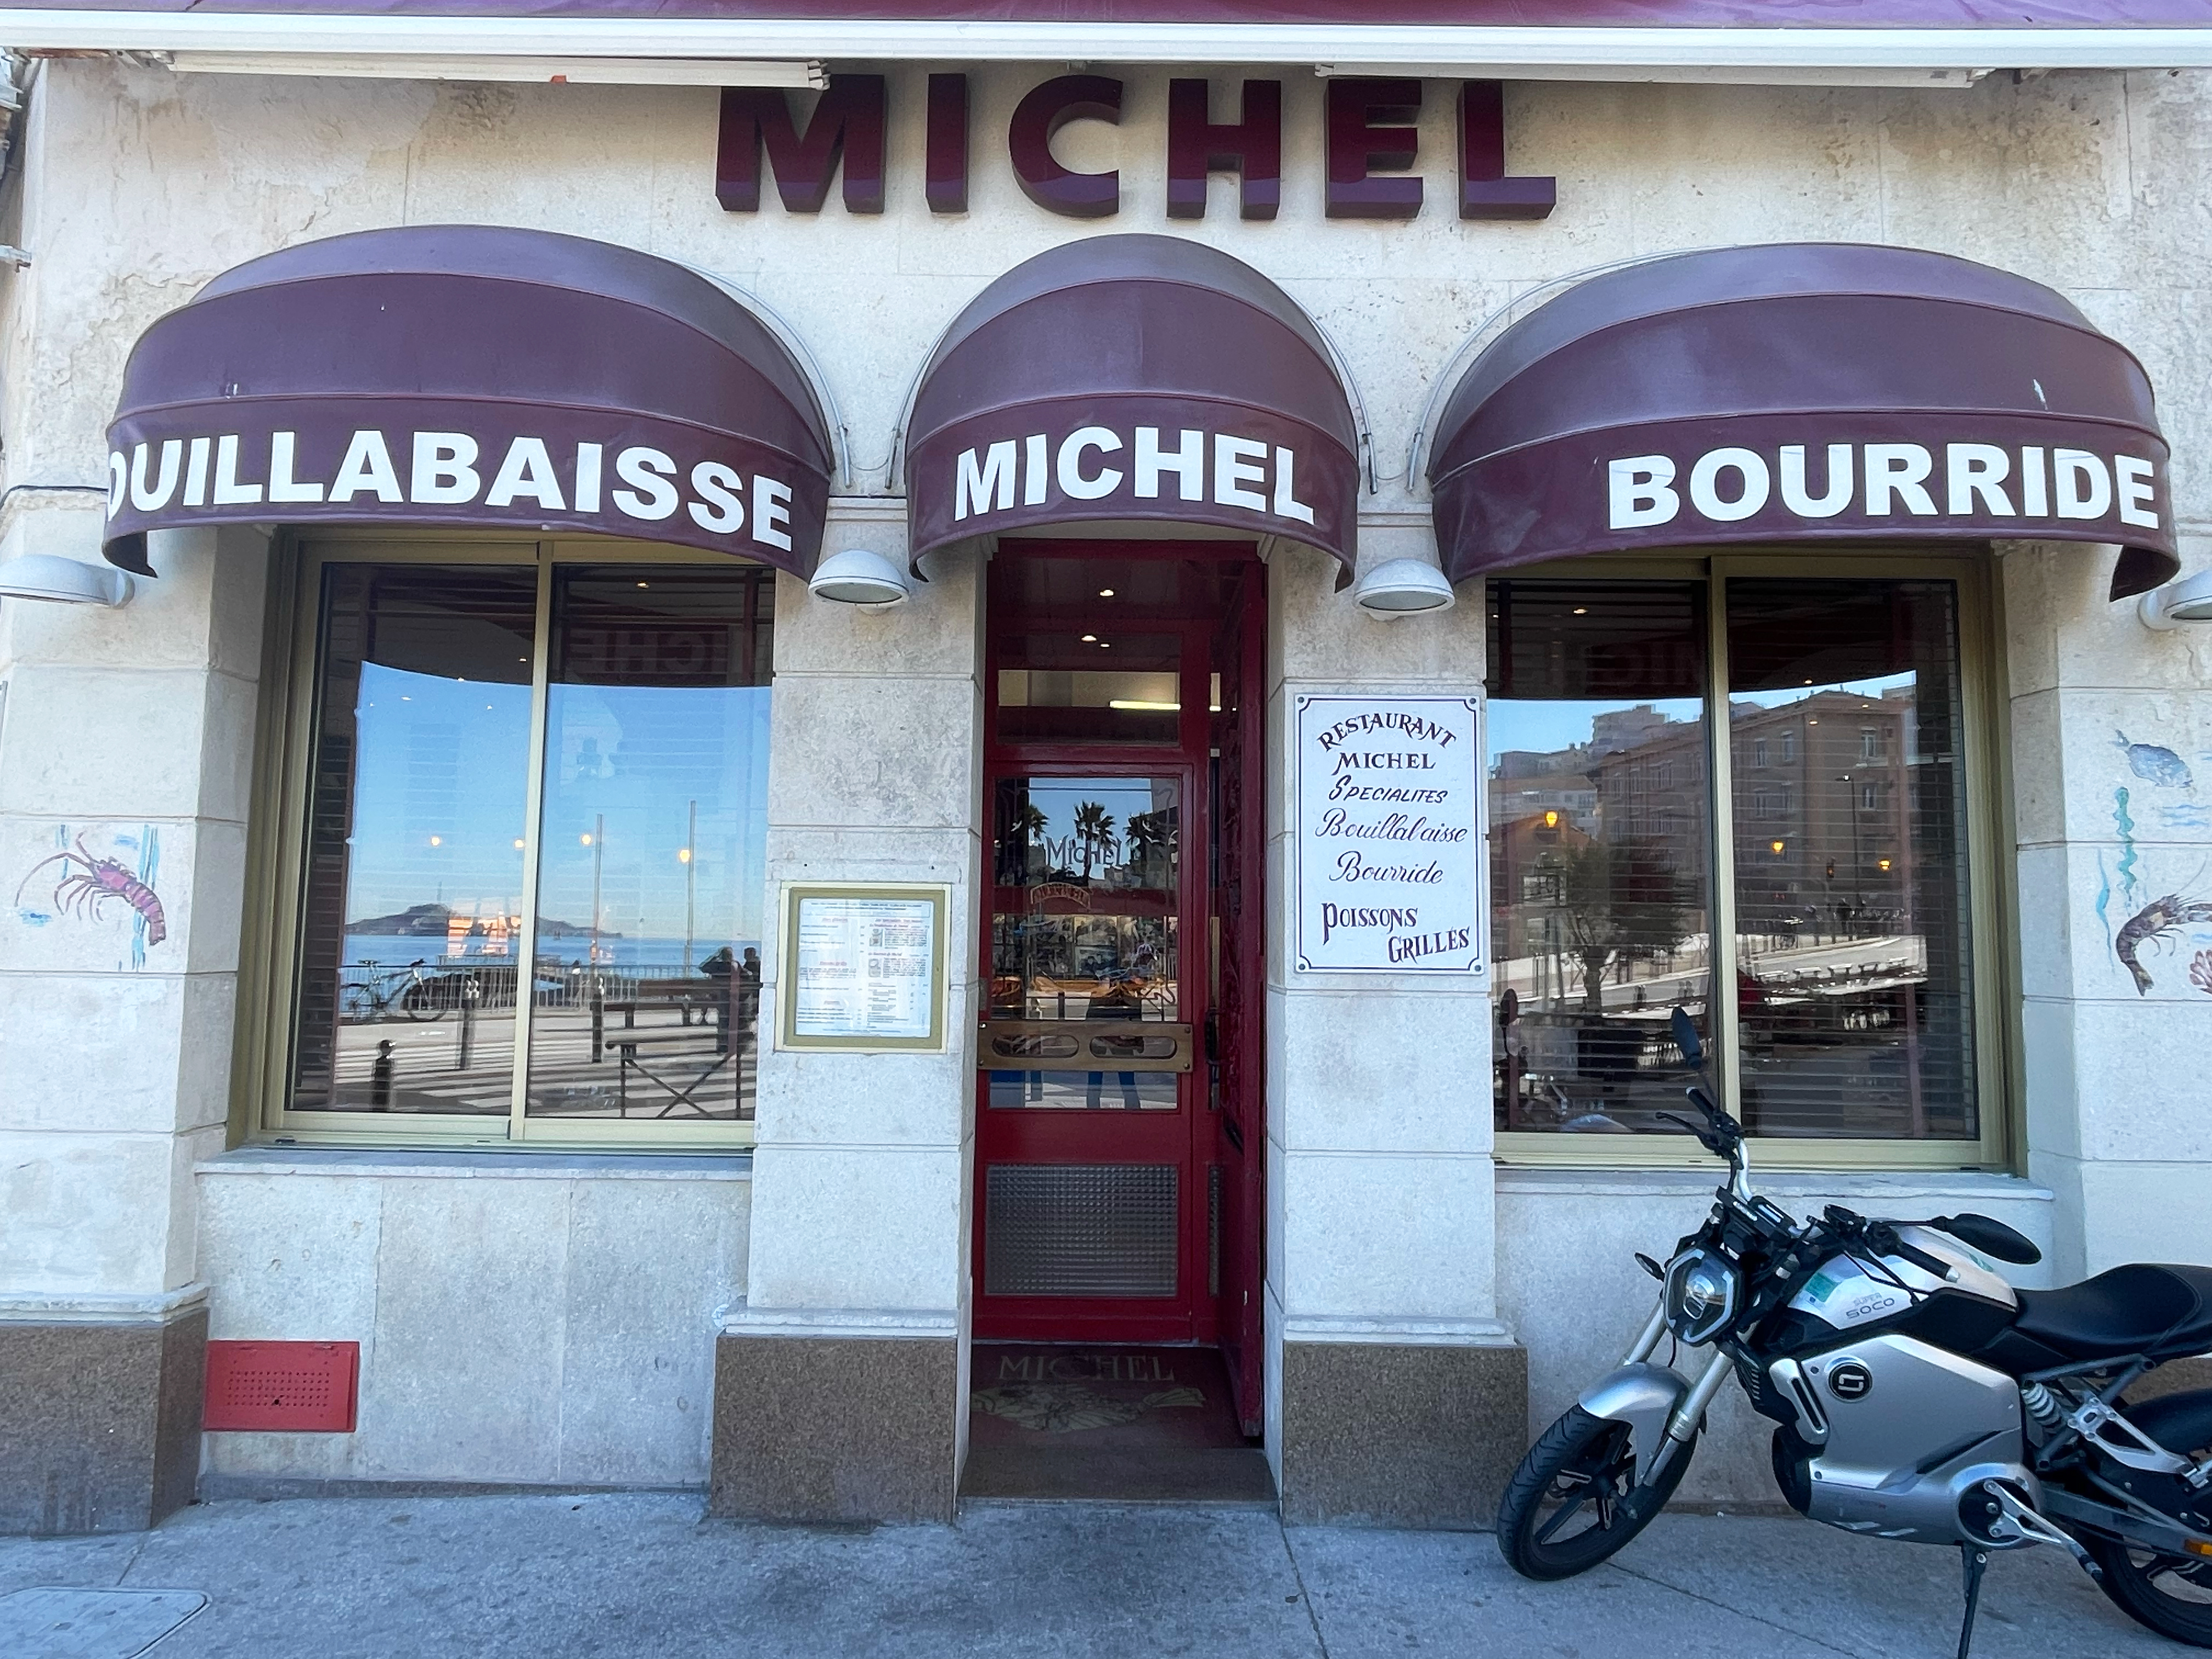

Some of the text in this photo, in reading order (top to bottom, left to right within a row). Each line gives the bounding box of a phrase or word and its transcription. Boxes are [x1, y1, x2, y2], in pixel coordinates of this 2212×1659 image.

[715, 74, 1556, 221] MICHEL
[955, 426, 1315, 525] MICHEL
[1609, 443, 2159, 530] BOURRIDE
[1316, 712, 1457, 752] RESTAURANT
[1331, 752, 1436, 776] MICHEL
[1329, 775, 1448, 804] SPECIALITES
[1329, 850, 1443, 884] Bourride
[1322, 902, 1418, 945] POISSONS
[1846, 1297, 1895, 1319] SOCO
[998, 1354, 1175, 1381] MICHEL
